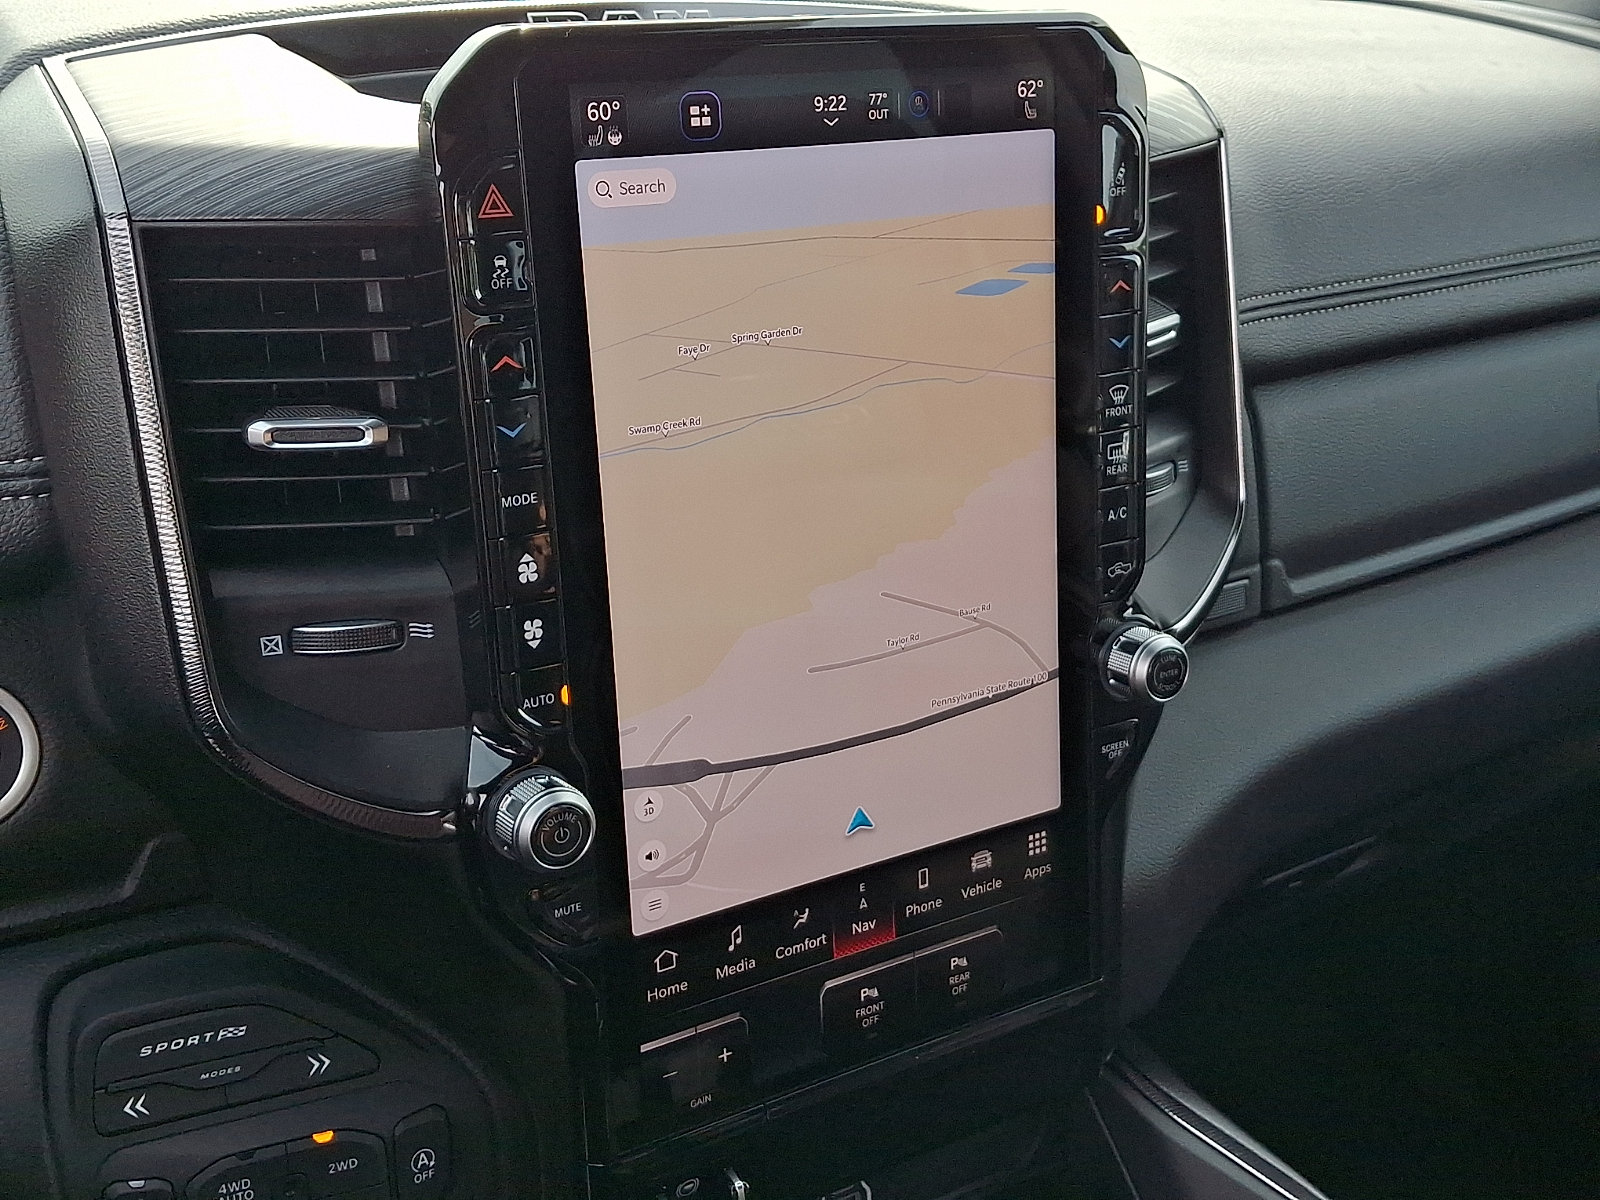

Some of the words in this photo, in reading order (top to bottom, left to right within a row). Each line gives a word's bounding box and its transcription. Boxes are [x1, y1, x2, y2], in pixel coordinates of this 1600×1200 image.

[1017, 79, 1044, 98] 62°
[813, 95, 848, 112] 9:22
[868, 93, 888, 106] 77°
[586, 101, 621, 121] 60°
[868, 109, 889, 120] OUT
[618, 178, 666, 196] Search
[1109, 186, 1127, 197] OFF
[491, 278, 513, 290] OFF
[731, 332, 759, 344] Spring
[760, 328, 791, 339] Garden
[792, 326, 803, 335] Dr
[678, 347, 698, 356] Faye
[699, 344, 711, 352] Dr
[1105, 404, 1133, 418] FRONT
[628, 425, 661, 436] Swamp
[662, 420, 687, 431] Creek
[689, 417, 701, 427] Rd
[1106, 463, 1128, 476] REAR
[501, 492, 538, 508] MODE
[1107, 506, 1128, 522] A/C
[959, 607, 980, 617] Bause
[981, 603, 991, 611] Rd
[886, 637, 909, 648] Taylor
[909, 633, 920, 641] Rd
[931, 689, 985, 708] Pennsylvania
[985, 684, 1006, 696] State
[1007, 679, 1031, 689] Route
[1033, 672, 1048, 682] 100
[522, 692, 555, 710] AUTO
[1101, 740, 1129, 754] SCREEN
[1108, 749, 1123, 759] OFF
[643, 806, 655, 817] 3D
[541, 814, 578, 833] VOLUME
[1024, 862, 1052, 881] Apps
[860, 883, 866, 892] E
[960, 876, 1003, 900] Vehicle
[553, 902, 582, 918] MUTE
[905, 896, 943, 918] Phone
[851, 918, 877, 935] Nav
[775, 933, 828, 960] Comfort
[715, 958, 756, 980] Media
[948, 971, 971, 986] REAR
[647, 979, 688, 1003] Home
[951, 982, 968, 996] OFF
[855, 1001, 886, 1019] FRONT
[861, 1014, 880, 1028] OFF
[139, 1031, 215, 1057] SPORT
[200, 1065, 241, 1080] MODES
[690, 1093, 712, 1109] GAIN
[328, 1158, 358, 1174] 2WD
[413, 1168, 436, 1184] OFF
[218, 1178, 251, 1194] 4WD
